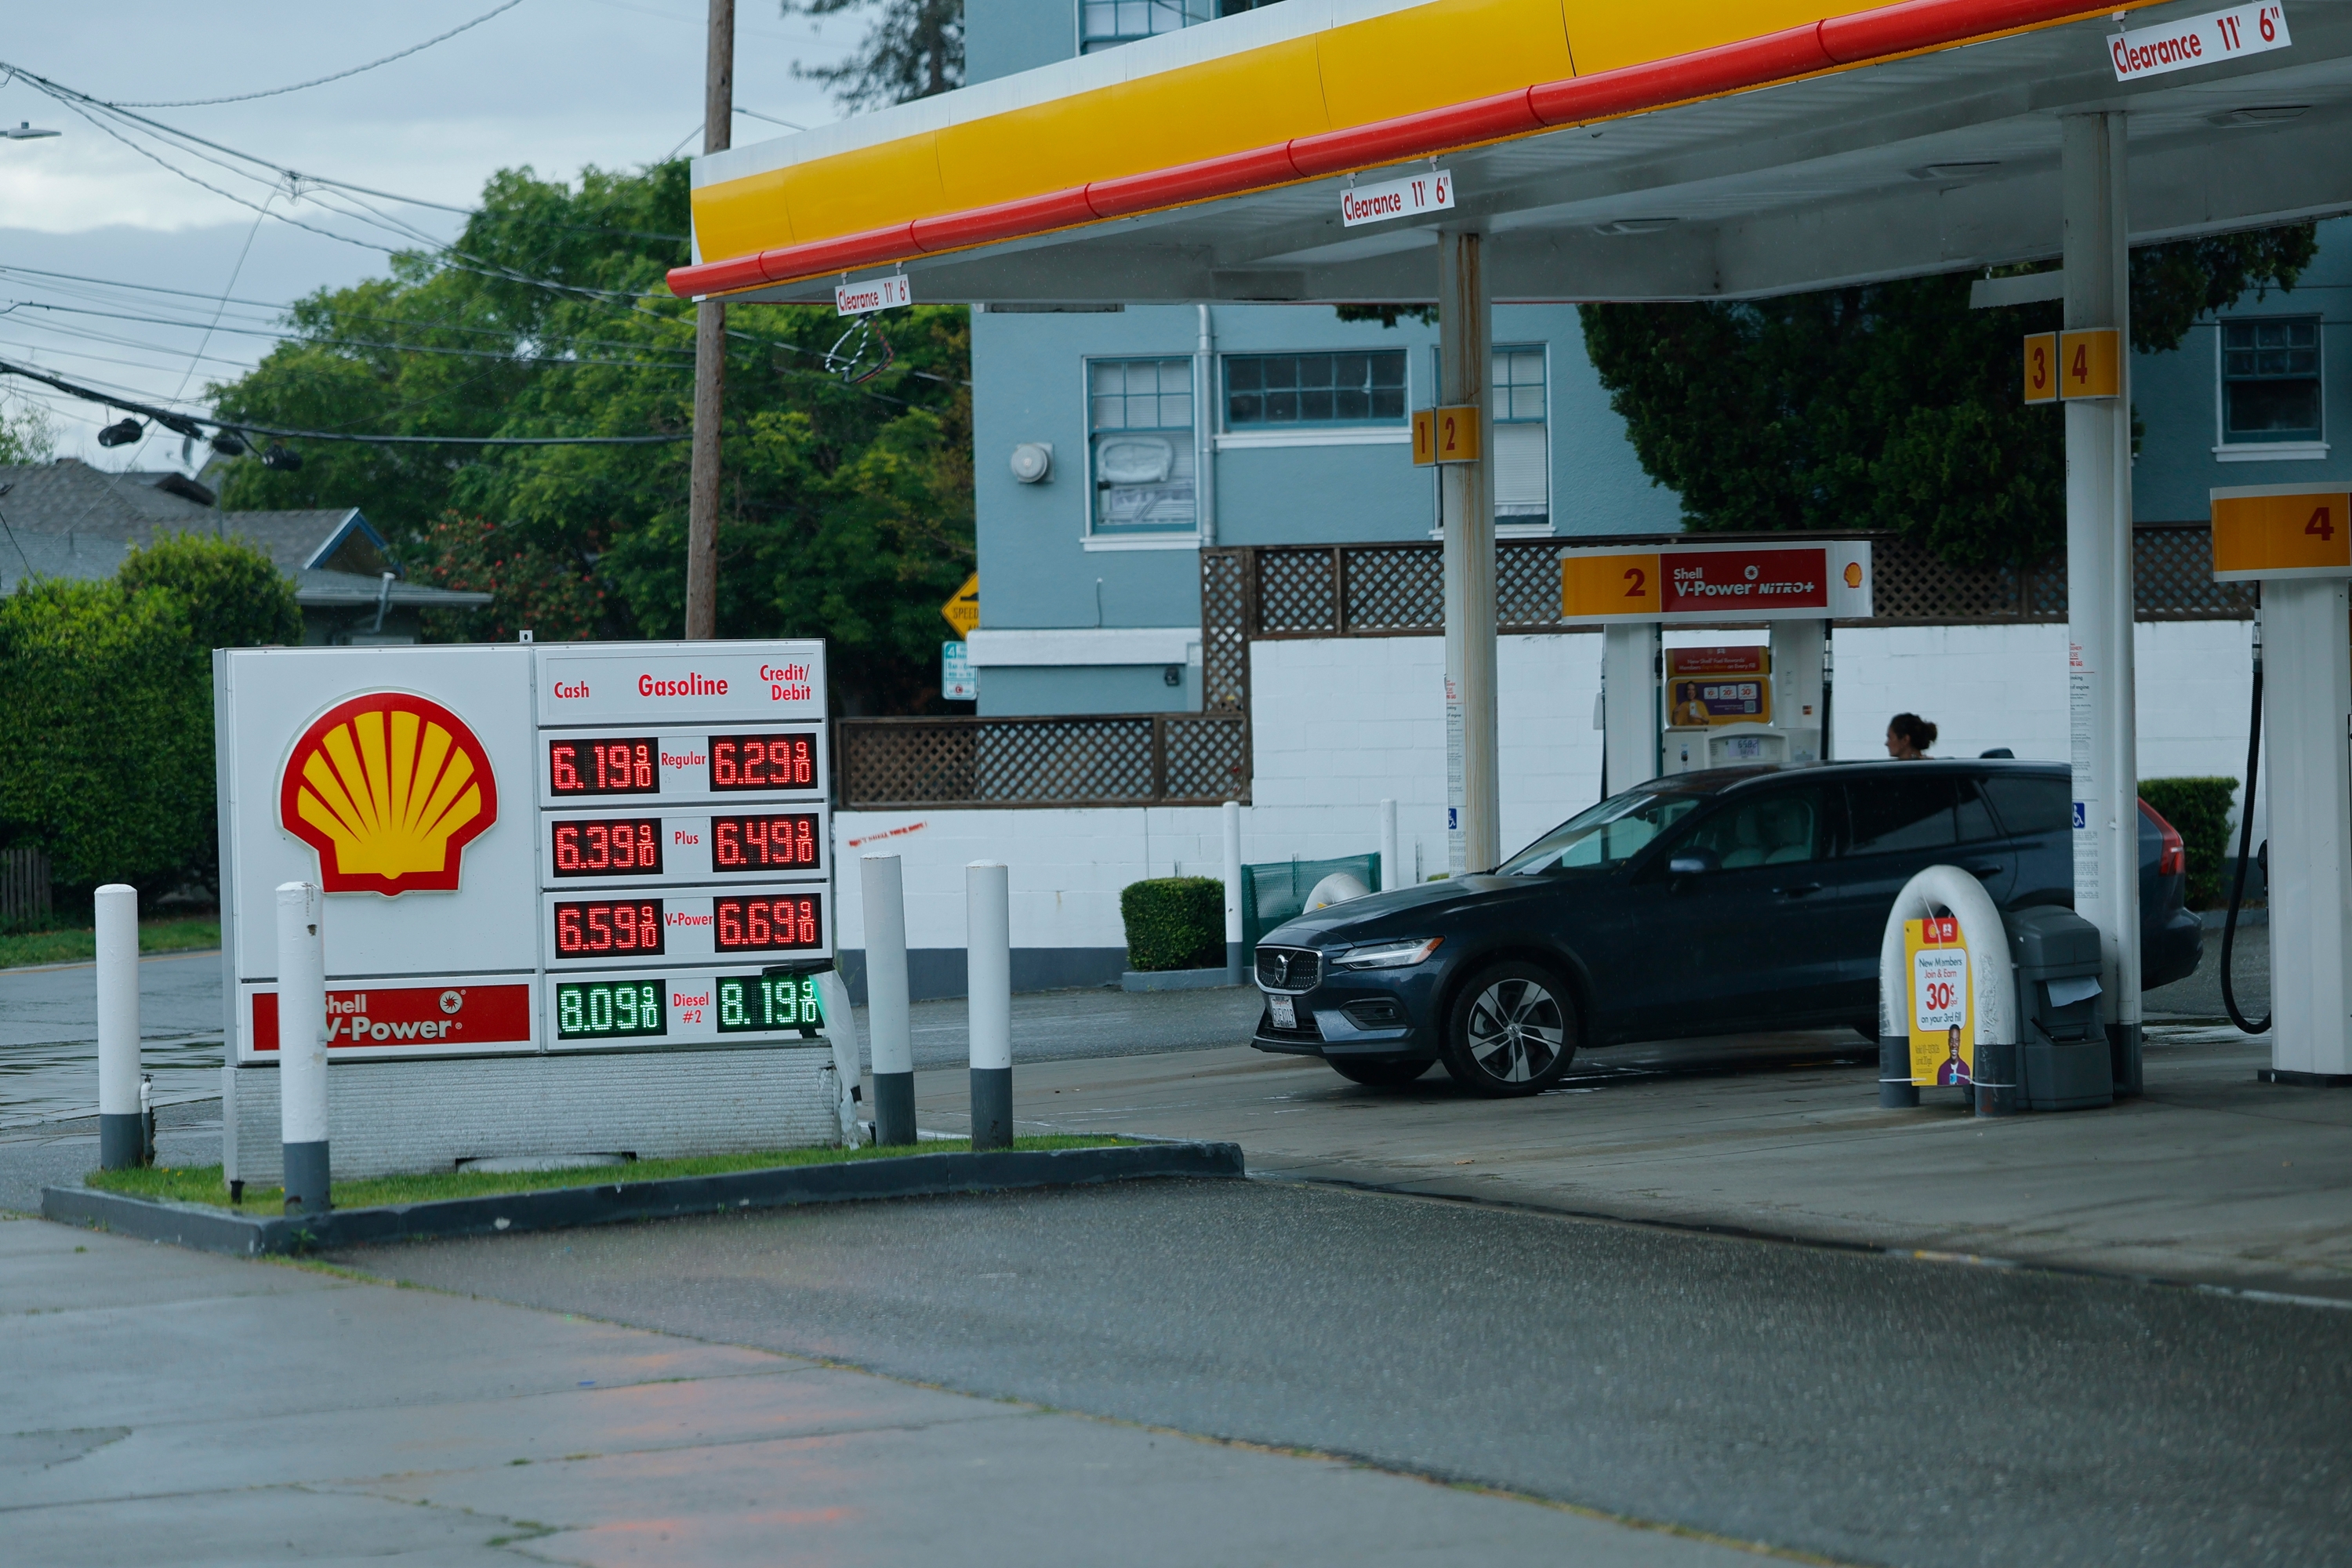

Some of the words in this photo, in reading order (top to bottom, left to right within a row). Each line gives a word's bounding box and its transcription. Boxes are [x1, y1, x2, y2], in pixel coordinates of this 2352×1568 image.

[2113, 34, 2202, 74] Clearance
[2217, 16, 2241, 51] 11'
[2259, 6, 2280, 42] 6"
[1344, 192, 1402, 221] Clearance
[1411, 180, 1426, 207] 11'
[1436, 176, 1449, 204] 6"
[838, 289, 879, 312] Clearance
[884, 281, 894, 303] 11'
[2033, 347, 2045, 390] 3
[2072, 344, 2088, 384] 4
[1420, 422, 1425, 454] 1
[1445, 417, 1455, 451] 2
[2305, 506, 2335, 541] 4
[1624, 568, 1646, 597] 2
[1674, 567, 1703, 580] Shell
[1674, 580, 1751, 597] V-Power
[953, 607, 979, 620] SPEED
[637, 673, 729, 698] Gasoline
[759, 663, 811, 683] Credit/
[554, 681, 590, 699] Cash
[771, 683, 811, 701] Debit
[553, 745, 631, 789] 6.19
[661, 751, 706, 768] Regular
[714, 741, 790, 786] 6.29
[555, 825, 635, 870] 6.39
[674, 831, 699, 845] Plus
[717, 821, 793, 865] 6.49
[557, 906, 637, 951] 6.59
[664, 913, 713, 927] V-Power
[719, 901, 795, 946] 6.69
[1918, 957, 1934, 967] New
[1935, 956, 1962, 967] Members
[1924, 969, 1936, 978] Join
[1937, 969, 1943, 978] &
[1944, 968, 1957, 978] Earn
[326, 994, 367, 1014] hell
[561, 986, 638, 1033] 8.09
[673, 992, 710, 1007] Diesel
[721, 982, 798, 1025] 8.19
[326, 1017, 452, 1042] V-Power
[682, 1009, 702, 1024] #2
[1929, 1015, 1942, 1025] your
[1944, 1012, 1954, 1022] 3rd
